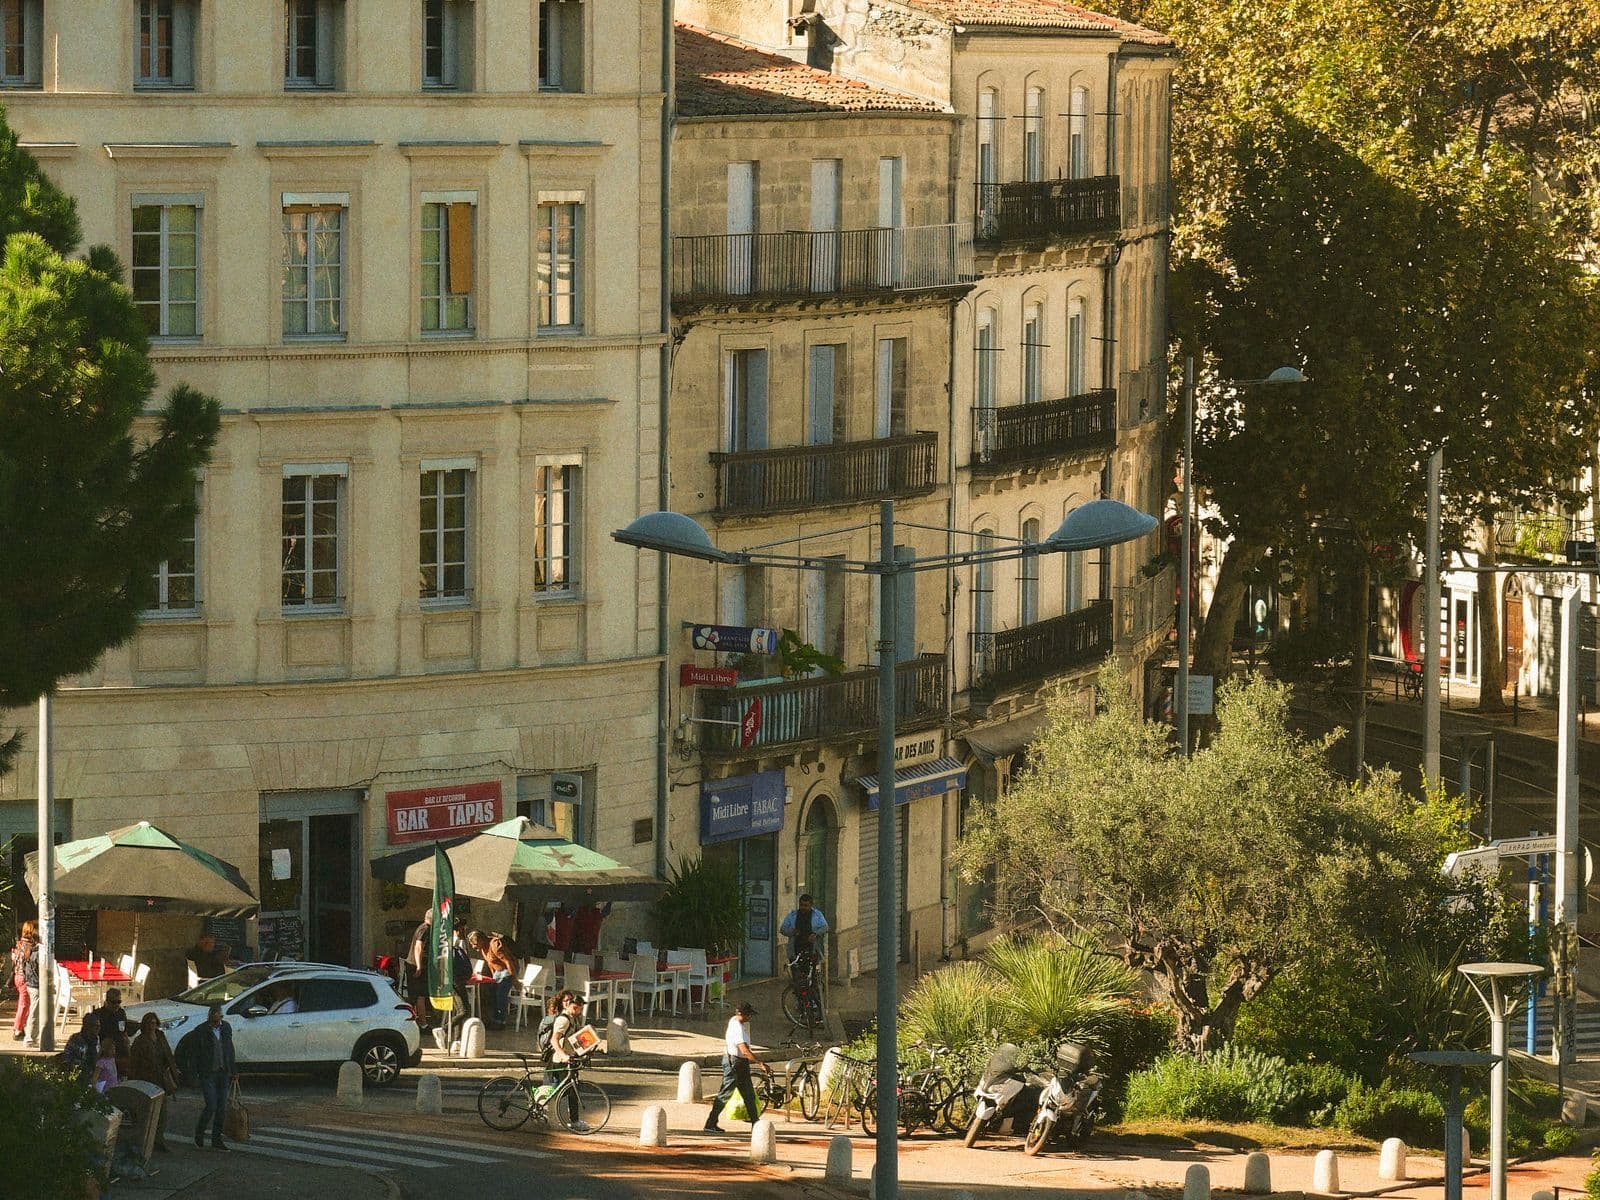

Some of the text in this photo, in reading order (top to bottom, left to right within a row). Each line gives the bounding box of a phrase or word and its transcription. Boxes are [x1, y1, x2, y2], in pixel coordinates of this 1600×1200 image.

[690, 672, 732, 684] Midi Libre
[894, 739, 934, 761] AR DES AMIS
[712, 802, 749, 821] Midi Libre
[752, 797, 778, 815] TABAC
[396, 801, 495, 832] BAR TAPAS
